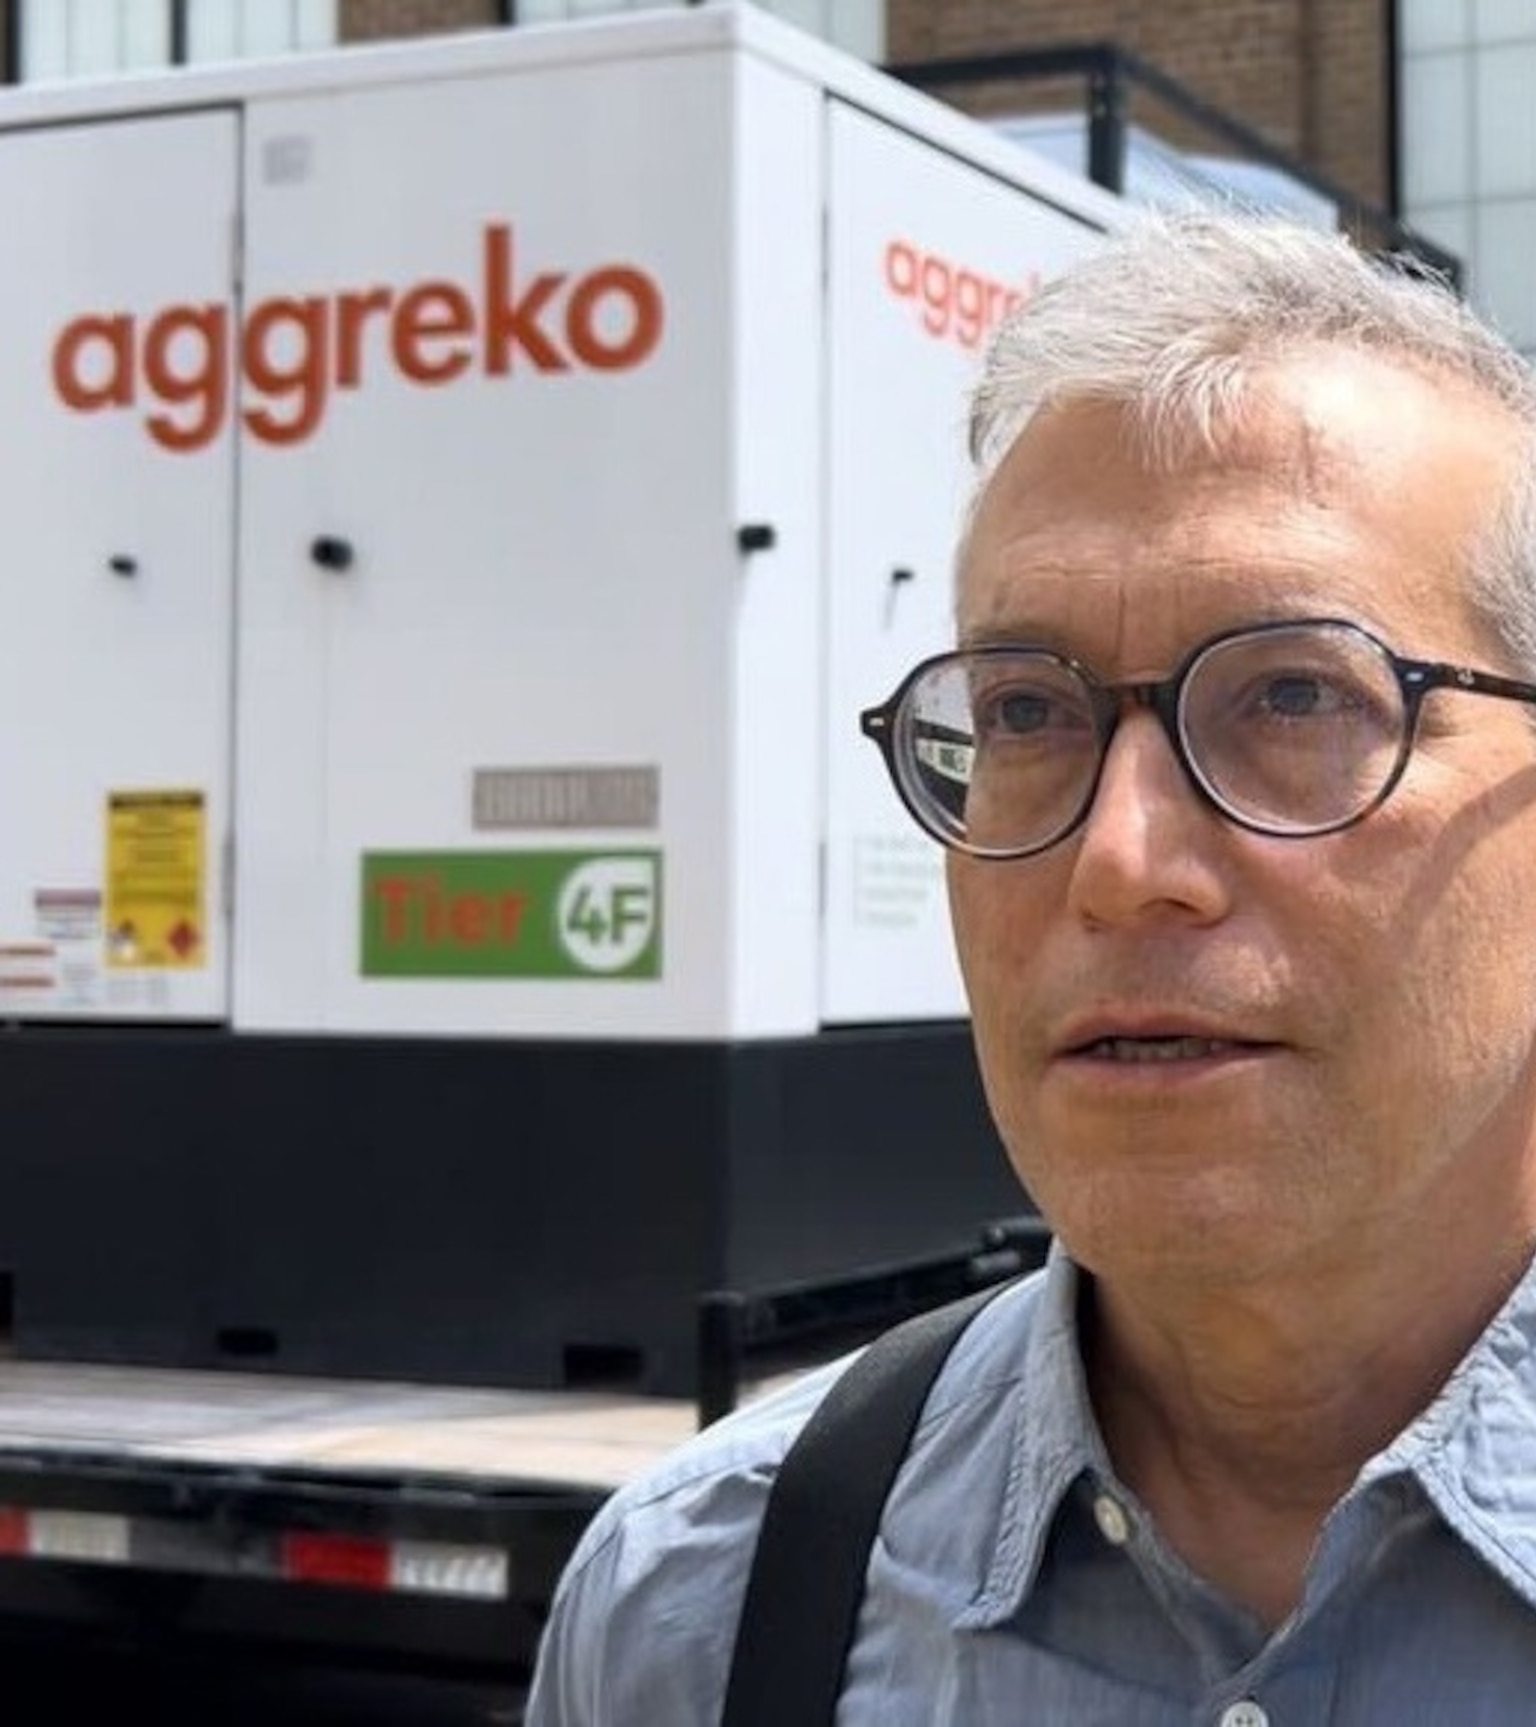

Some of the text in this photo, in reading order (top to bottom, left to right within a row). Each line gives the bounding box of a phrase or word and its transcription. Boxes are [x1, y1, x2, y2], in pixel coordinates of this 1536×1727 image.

[52, 223, 663, 451] aggreko
[885, 242, 1040, 348] aggr
[376, 873, 649, 944] Tier 4F
